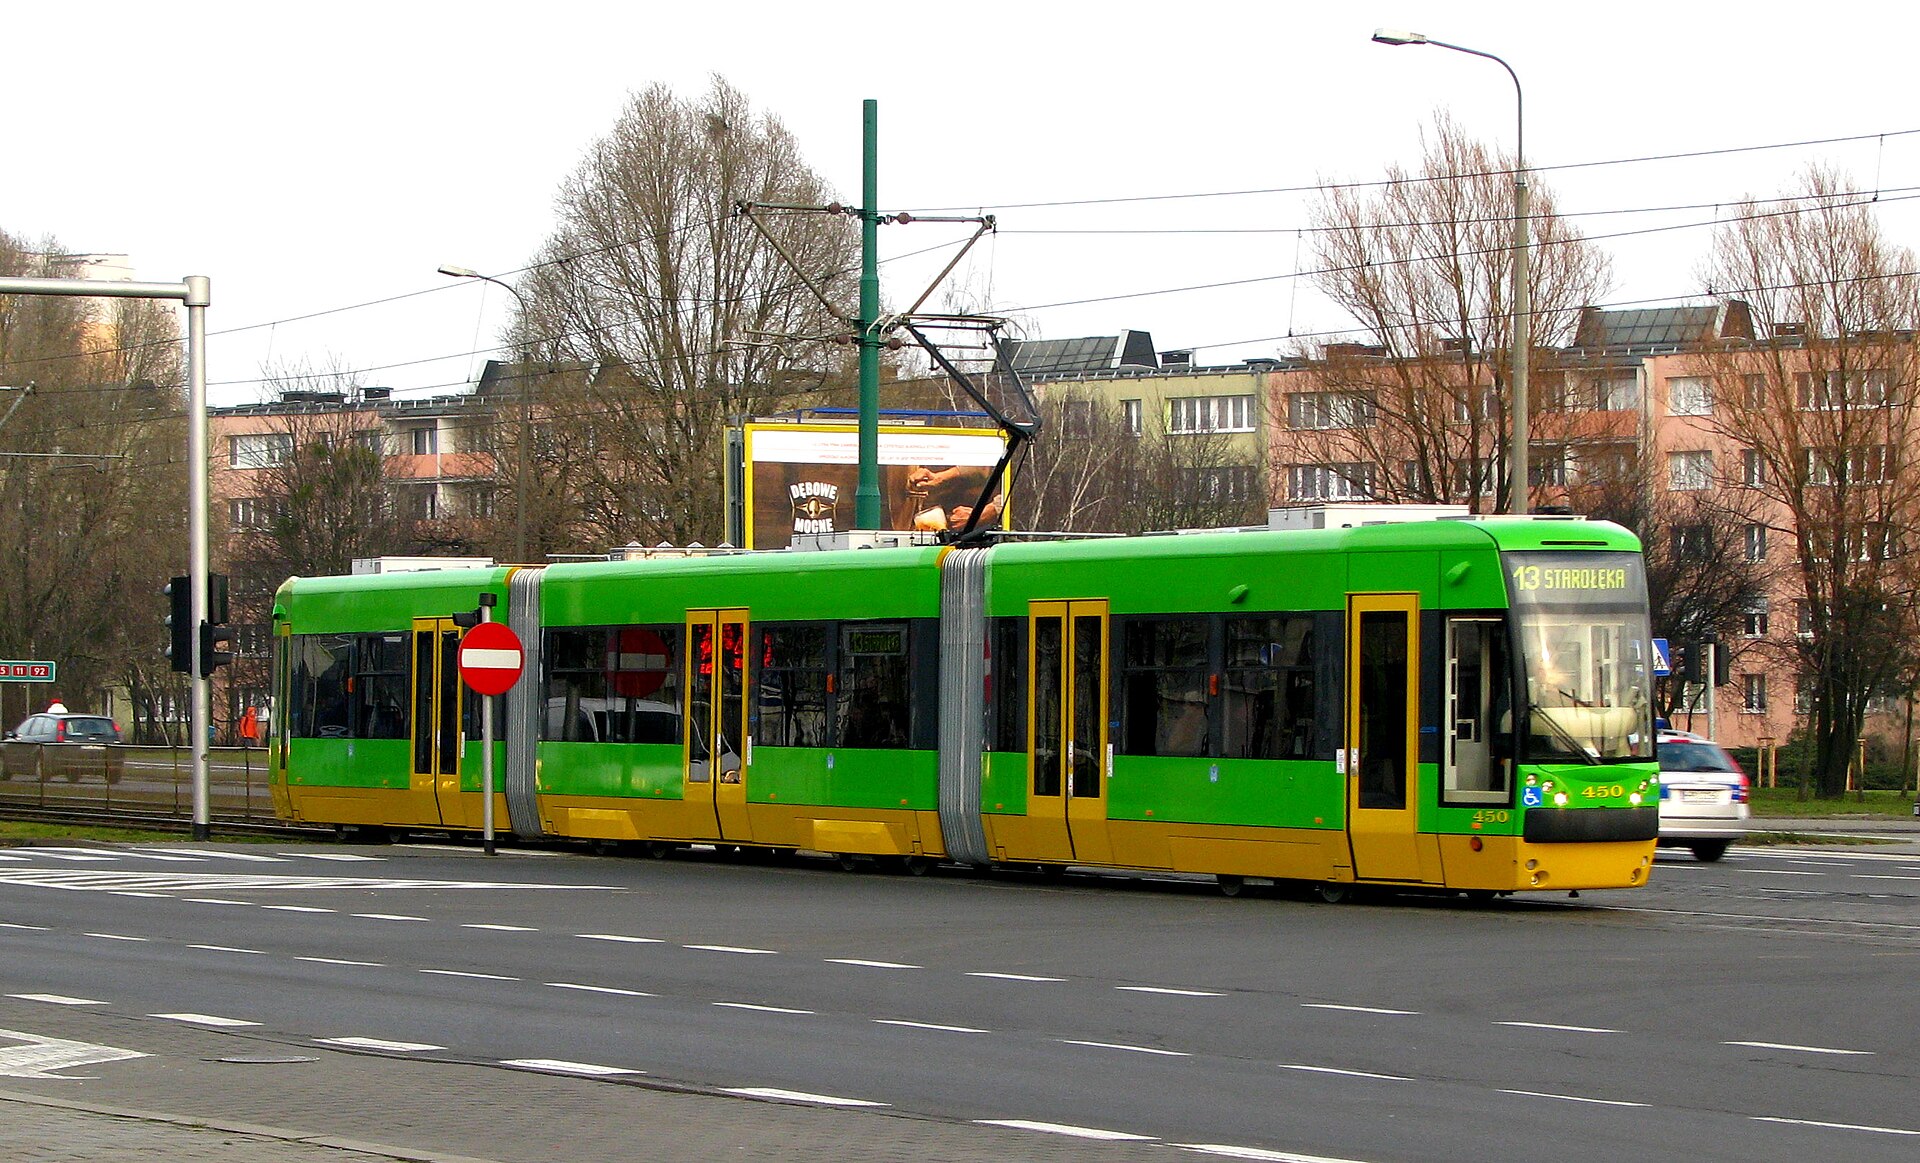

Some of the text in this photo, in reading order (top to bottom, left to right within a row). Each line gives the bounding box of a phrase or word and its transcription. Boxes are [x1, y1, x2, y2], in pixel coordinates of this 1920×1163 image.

[790, 481, 838, 500] DĘBOWE
[793, 517, 834, 534] MOCNE
[1513, 565, 1625, 591] 13 STAROŁĘKA
[16, 666, 24, 675] 11
[34, 667, 46, 676] 92
[1581, 784, 1625, 799] 450
[1472, 810, 1509, 824] 450
